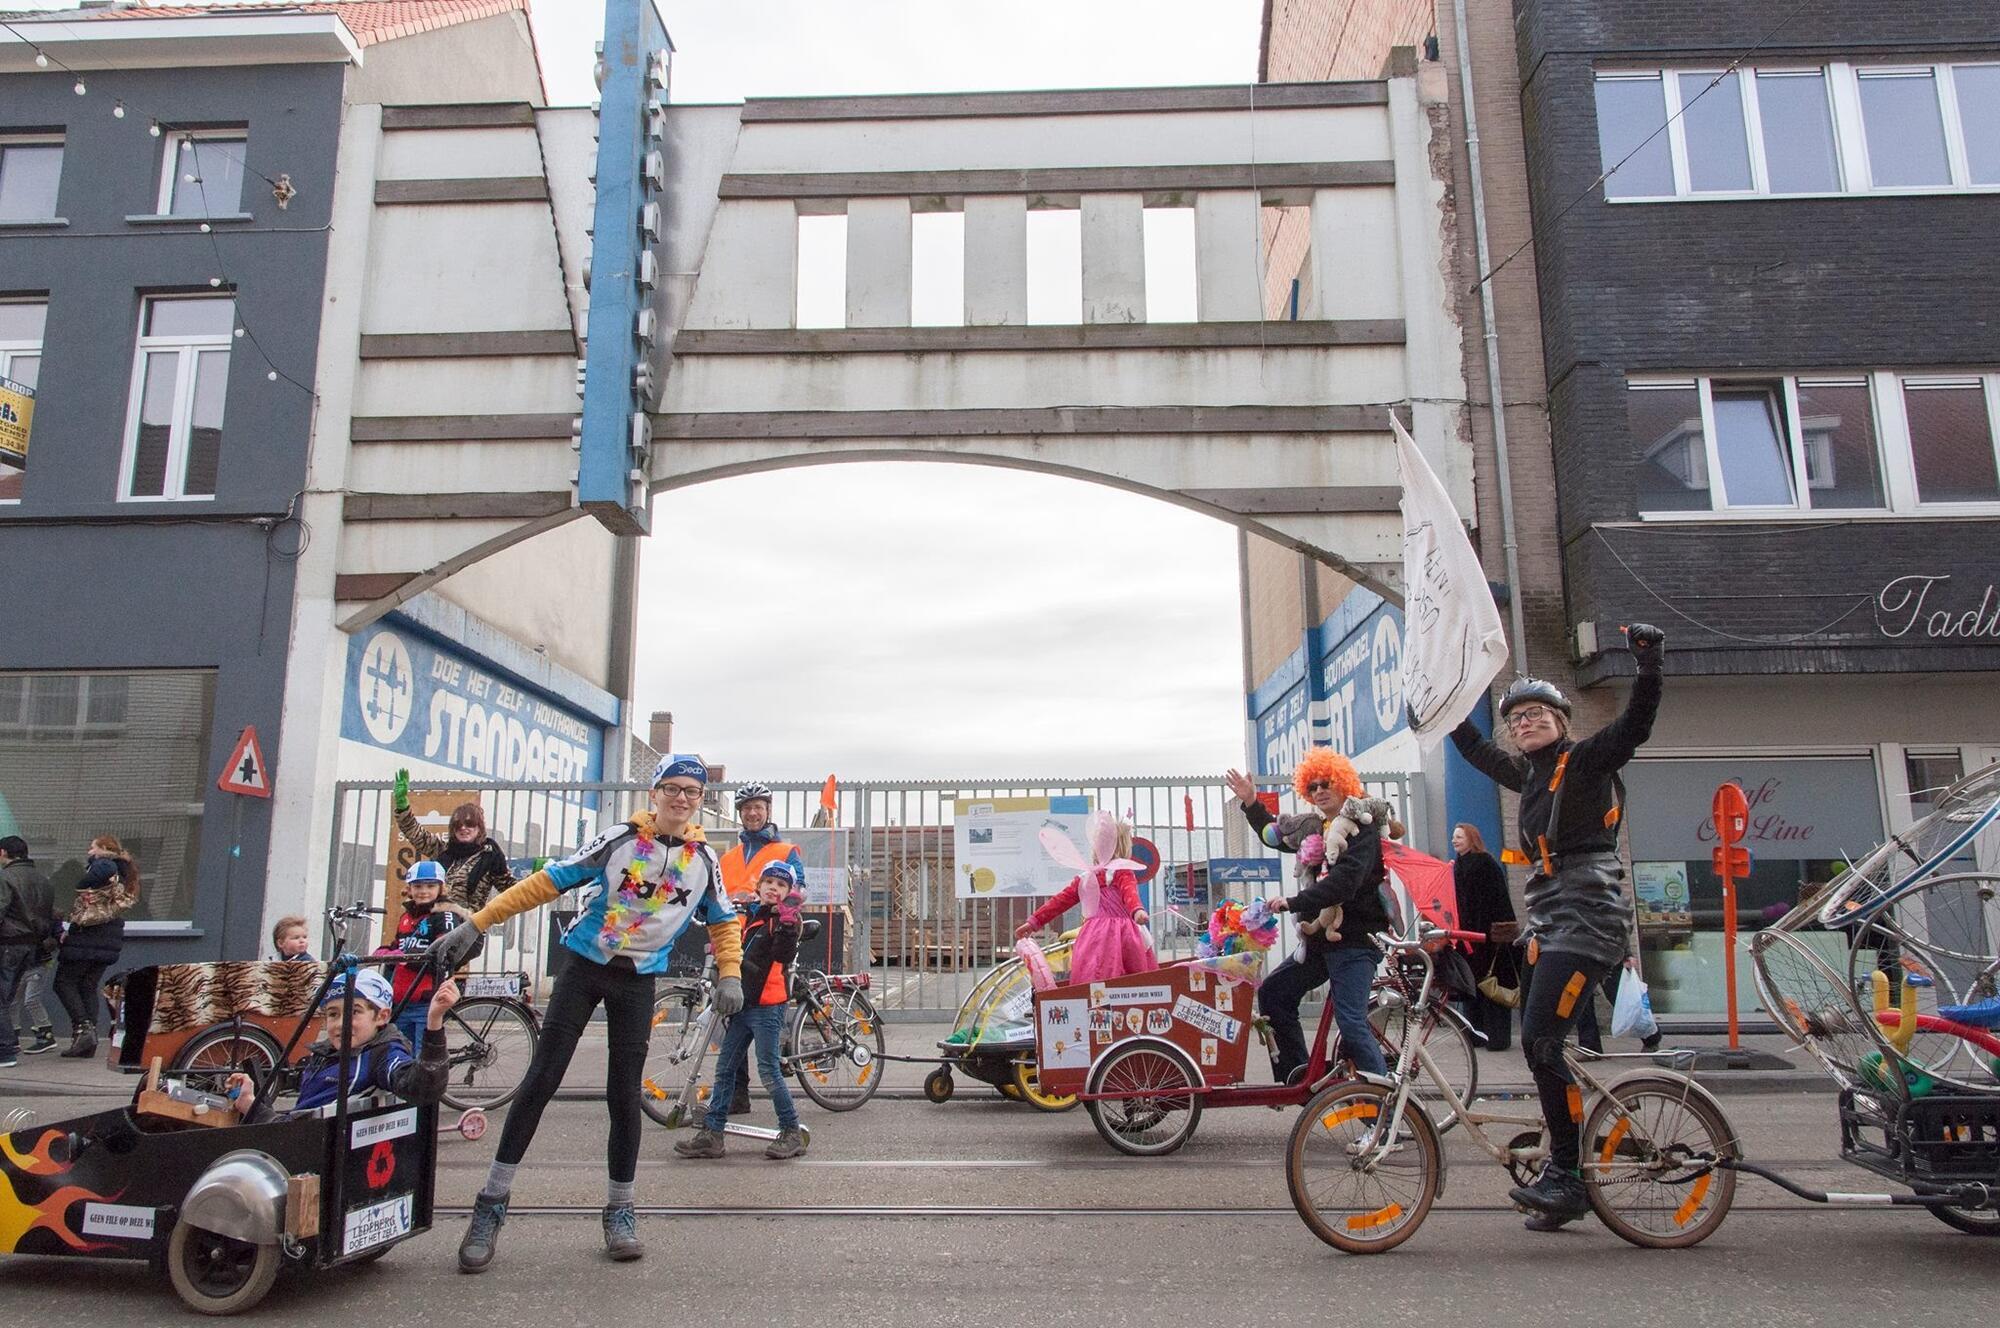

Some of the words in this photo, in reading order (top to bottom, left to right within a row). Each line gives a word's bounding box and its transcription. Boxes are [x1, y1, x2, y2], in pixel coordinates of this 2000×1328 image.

[432, 653, 462, 687] DOE
[467, 669, 492, 699] HET
[496, 683, 525, 712] ZELF
[534, 702, 591, 745] HOUTHANDEL
[424, 688, 588, 802] STANDAERT
[1748, 814, 1815, 842] Line
[89, 1213, 104, 1224] GEEN
[105, 1215, 118, 1225] FILE
[119, 1216, 129, 1226] OP
[129, 1217, 144, 1227] DEZE
